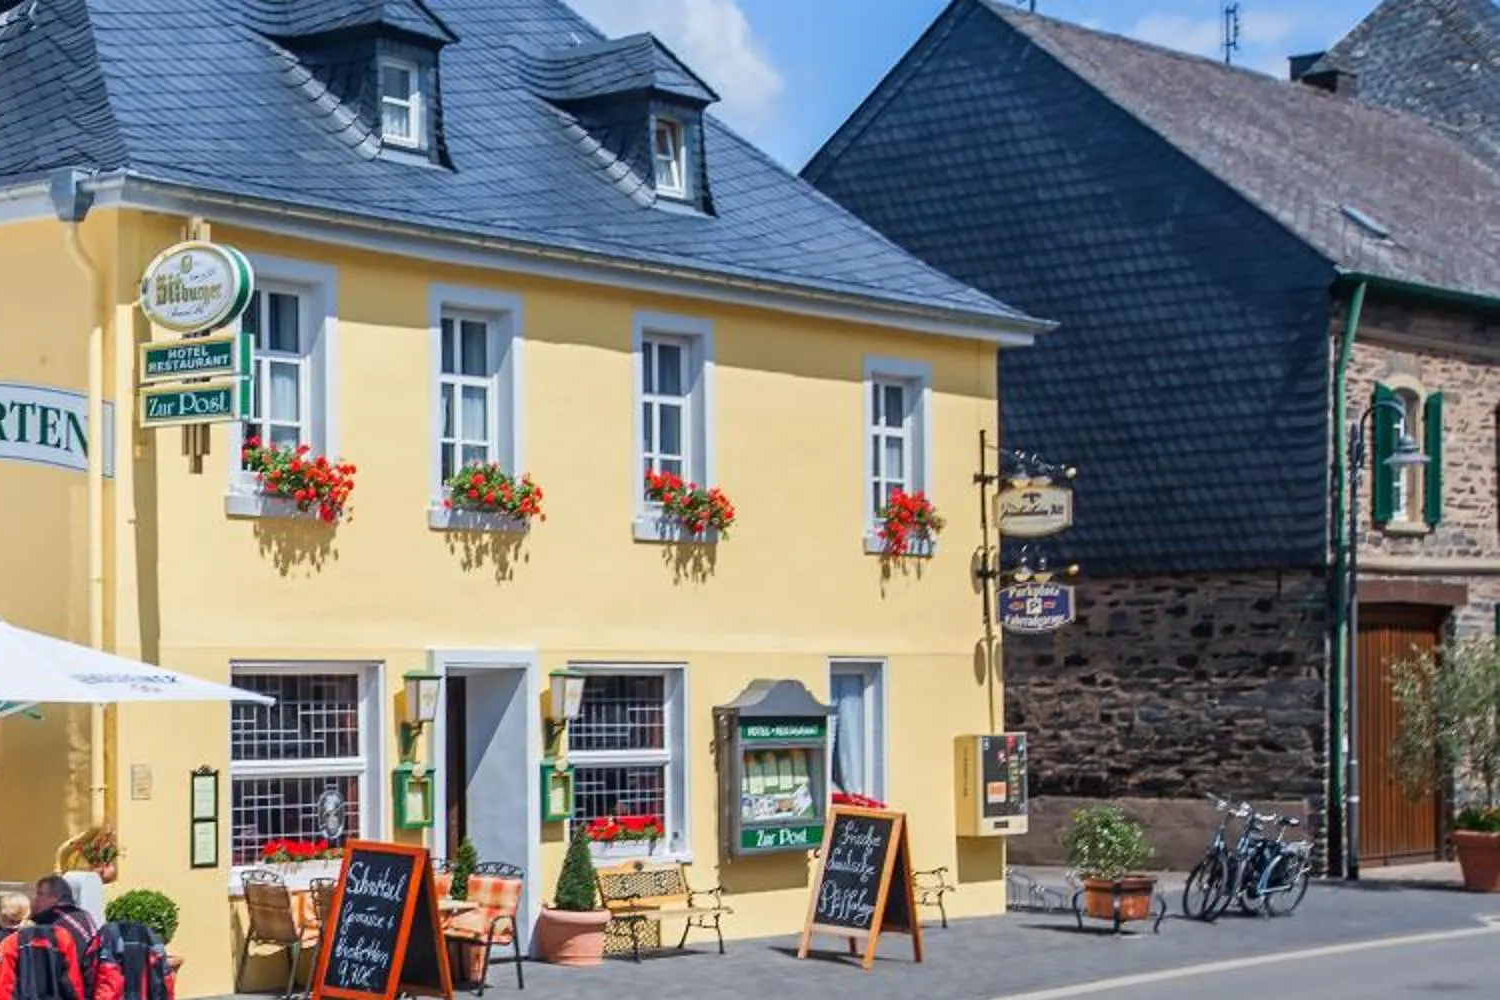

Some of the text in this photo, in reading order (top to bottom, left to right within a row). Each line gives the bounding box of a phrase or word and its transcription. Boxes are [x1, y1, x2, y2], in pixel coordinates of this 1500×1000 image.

[167, 345, 209, 360] HOTEL
[147, 354, 229, 373] RESTAURANT
[148, 398, 175, 417] Zur
